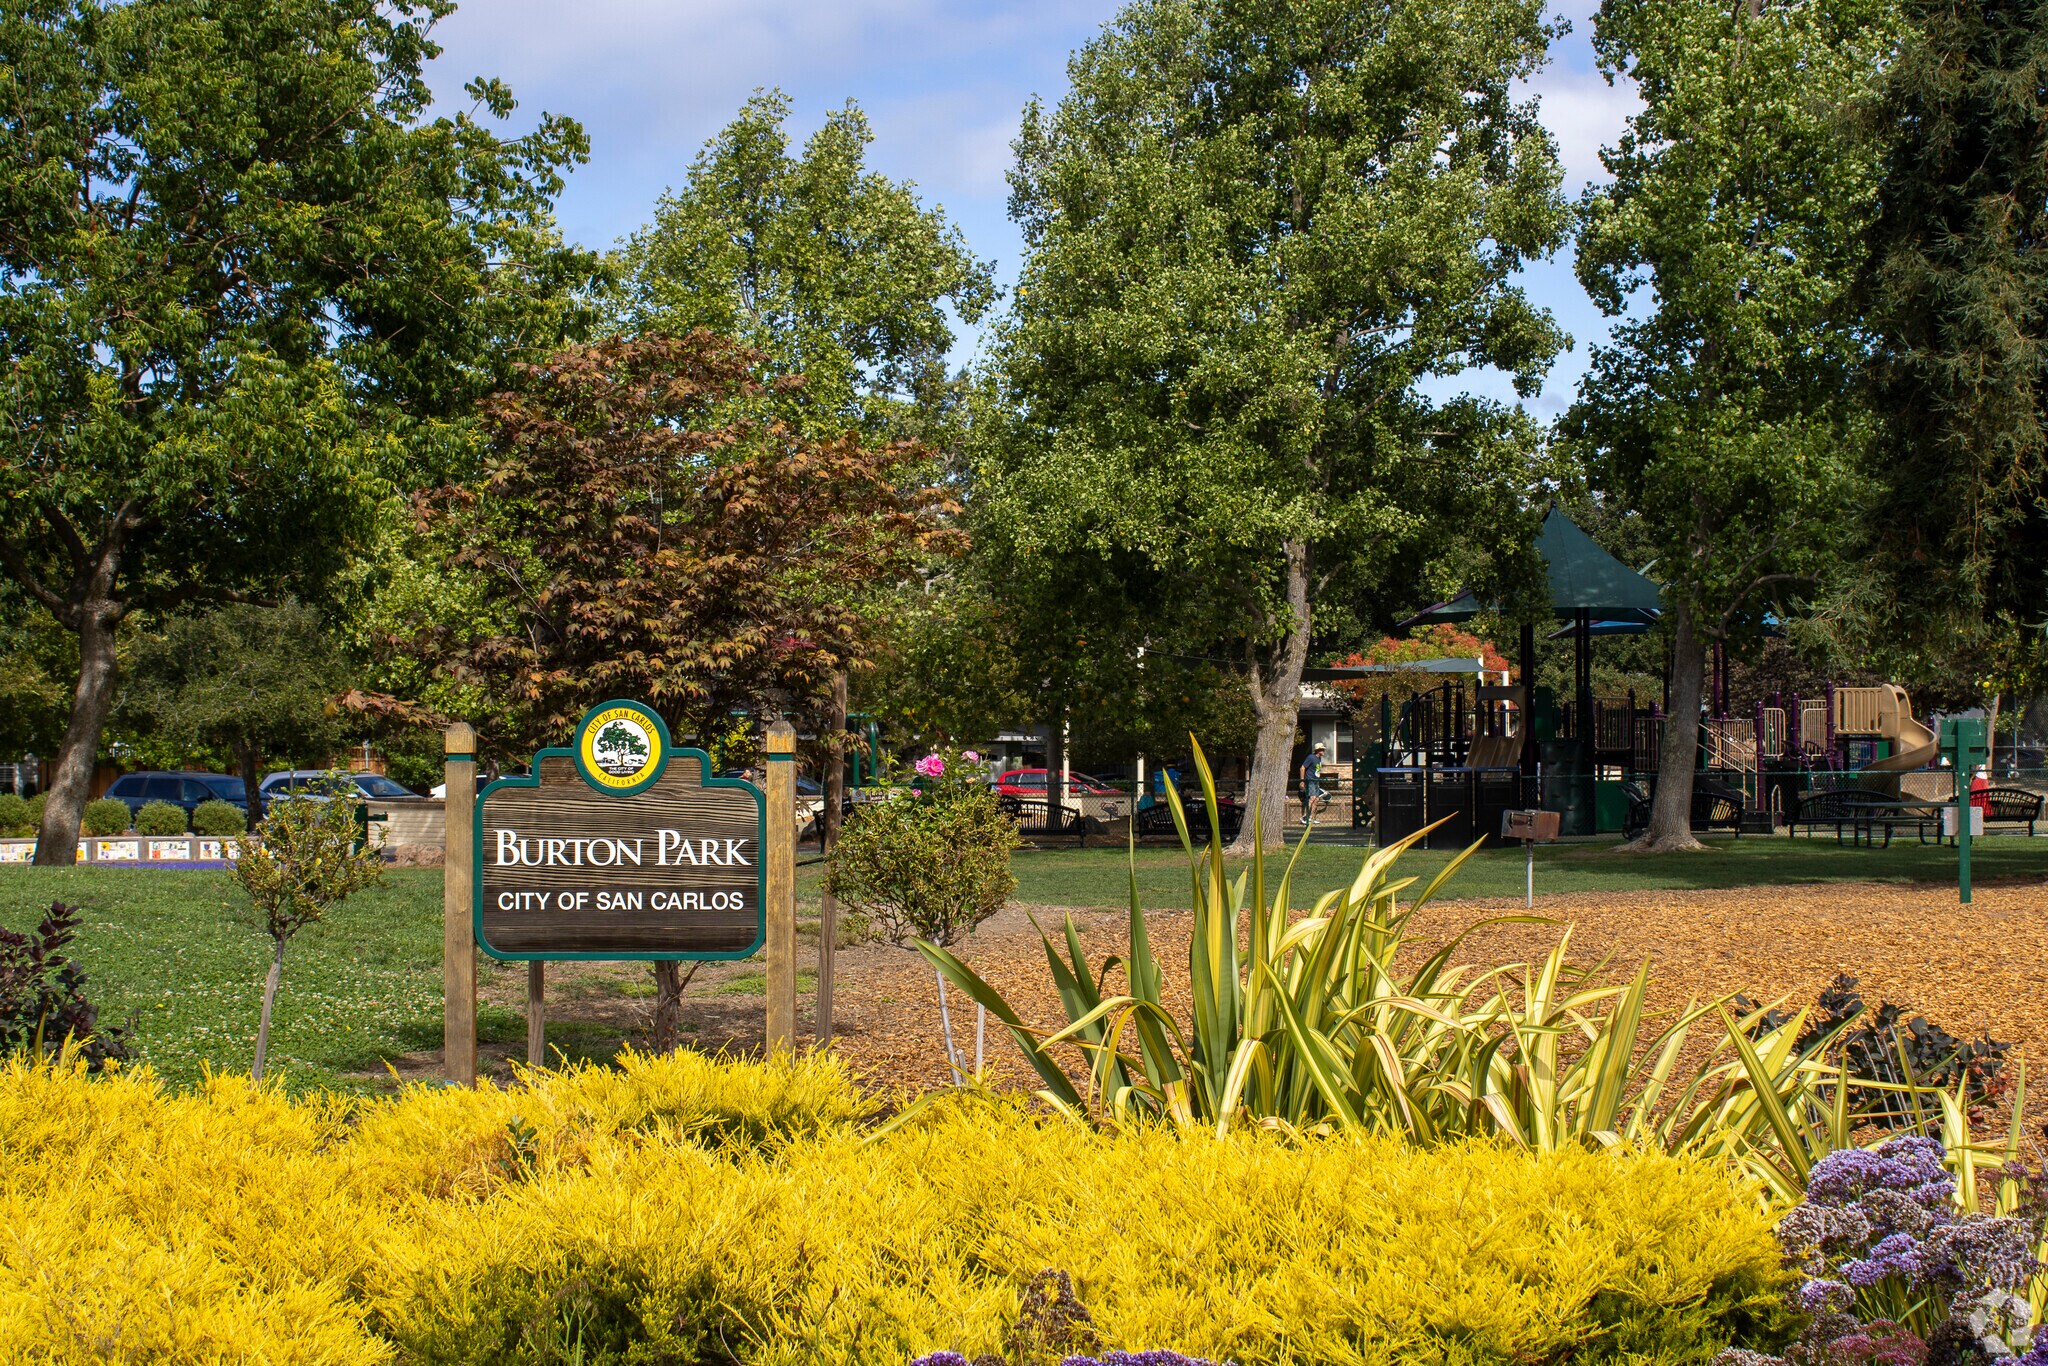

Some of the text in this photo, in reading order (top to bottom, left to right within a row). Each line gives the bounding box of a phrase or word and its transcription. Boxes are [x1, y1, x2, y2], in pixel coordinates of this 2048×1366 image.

[587, 710, 656, 735] CITY OF SAN CARLOS
[598, 772, 645, 786] CALIFORNIA
[493, 829, 752, 867] BURTON PARK
[498, 892, 744, 911] CITY OF SAN CARLOS
